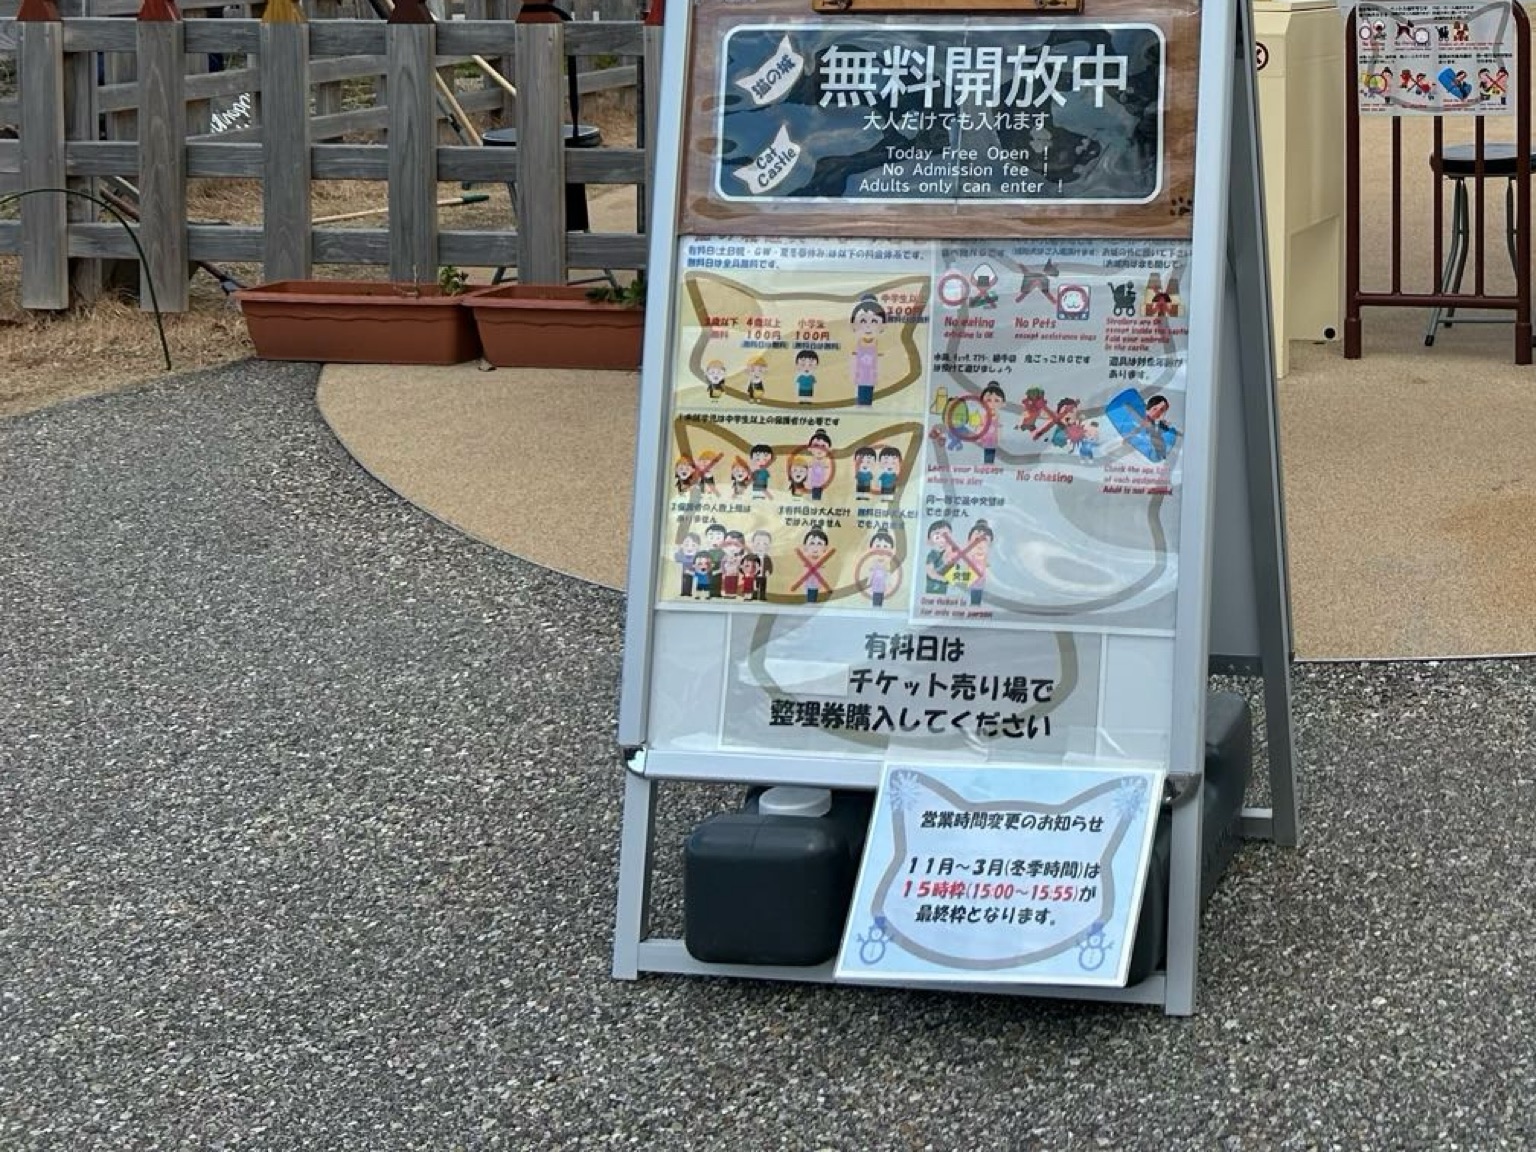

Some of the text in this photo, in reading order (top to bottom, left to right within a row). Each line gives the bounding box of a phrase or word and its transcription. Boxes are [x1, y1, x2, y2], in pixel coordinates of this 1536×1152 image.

[819, 45, 1128, 109] 無料開放中
[863, 112, 1050, 131] 大人だけでも入れます
[756, 147, 778, 170] Cat
[886, 146, 933, 161] Today
[942, 146, 978, 160] Free
[987, 146, 1030, 161] Open
[757, 148, 796, 187] Castle
[882, 163, 904, 176] No
[912, 163, 993, 176] Admission
[1003, 163, 1029, 176] fee
[859, 179, 910, 193] Adults
[918, 180, 952, 194] only
[962, 182, 991, 193] can
[1000, 182, 1045, 193] enter
[944, 317, 959, 327] No
[1015, 317, 1056, 329] No Pets
[1016, 470, 1074, 483] No chasing
[865, 631, 965, 663] 有料日は
[849, 668, 1054, 703] チケット売り場で
[769, 699, 1052, 738] 整理券購入してください
[920, 810, 1104, 833] 営業時間変更のお知らせ
[915, 904, 1057, 926] 最終枠となります。
